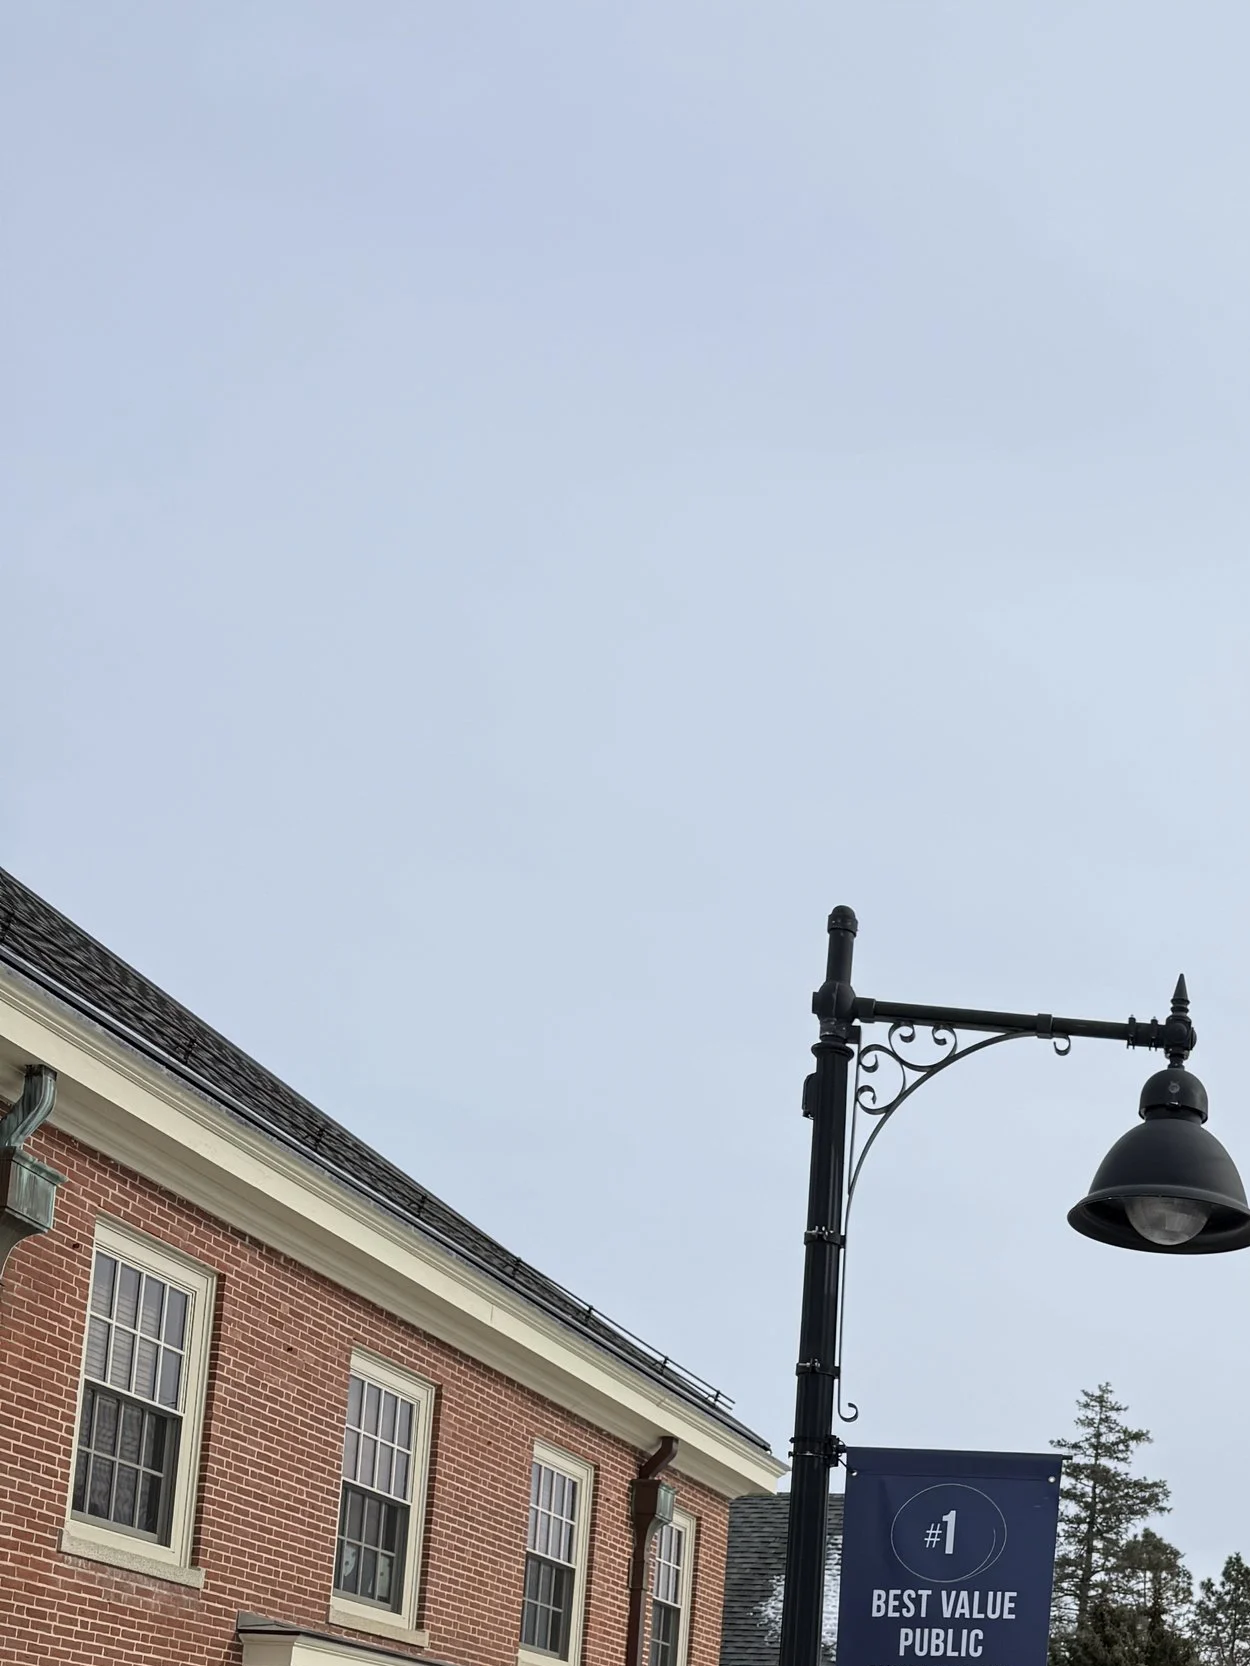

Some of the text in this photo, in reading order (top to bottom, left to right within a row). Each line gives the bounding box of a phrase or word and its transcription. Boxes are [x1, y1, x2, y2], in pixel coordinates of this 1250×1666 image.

[924, 1510, 956, 1554] #1
[871, 1589, 1017, 1619] BEST VALUE
[898, 1628, 984, 1657] PUBLIC
